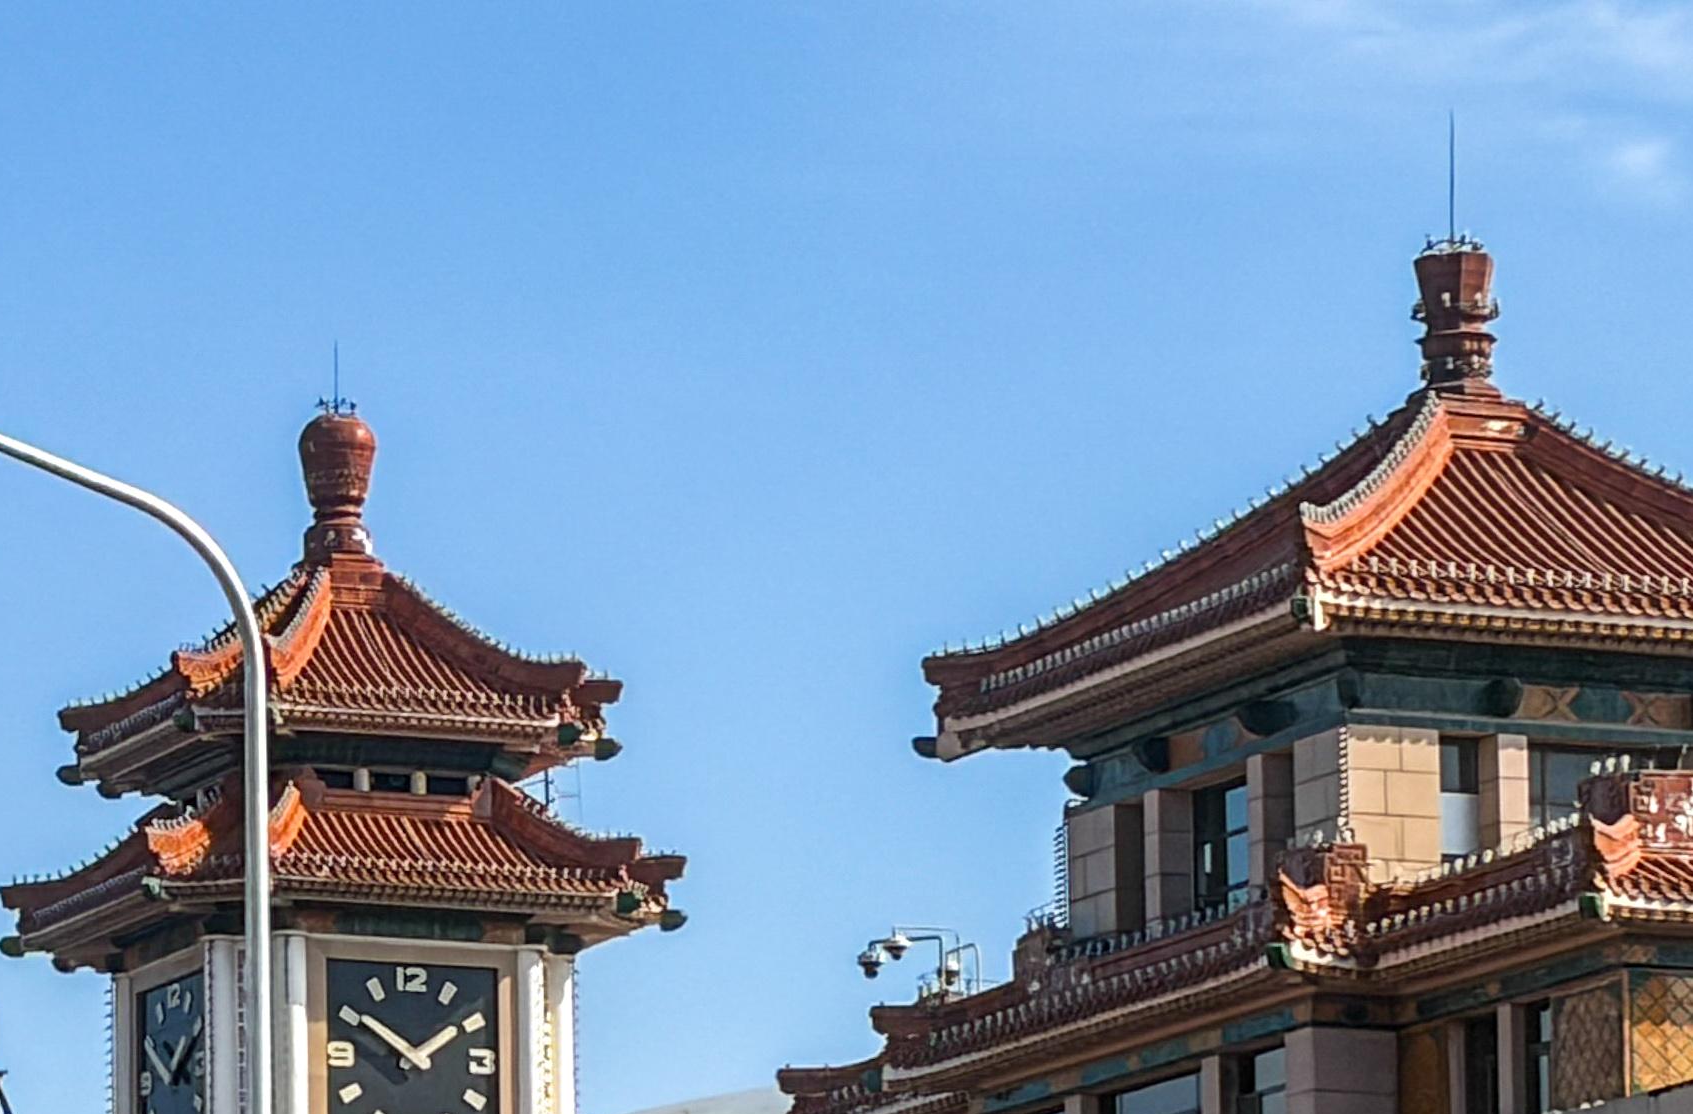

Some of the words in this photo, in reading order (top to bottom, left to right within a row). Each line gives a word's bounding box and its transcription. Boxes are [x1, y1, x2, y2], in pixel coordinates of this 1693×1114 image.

[395, 966, 428, 993] 12
[167, 983, 180, 1008] 12
[326, 1040, 355, 1067] 9
[468, 1048, 496, 1075] 3
